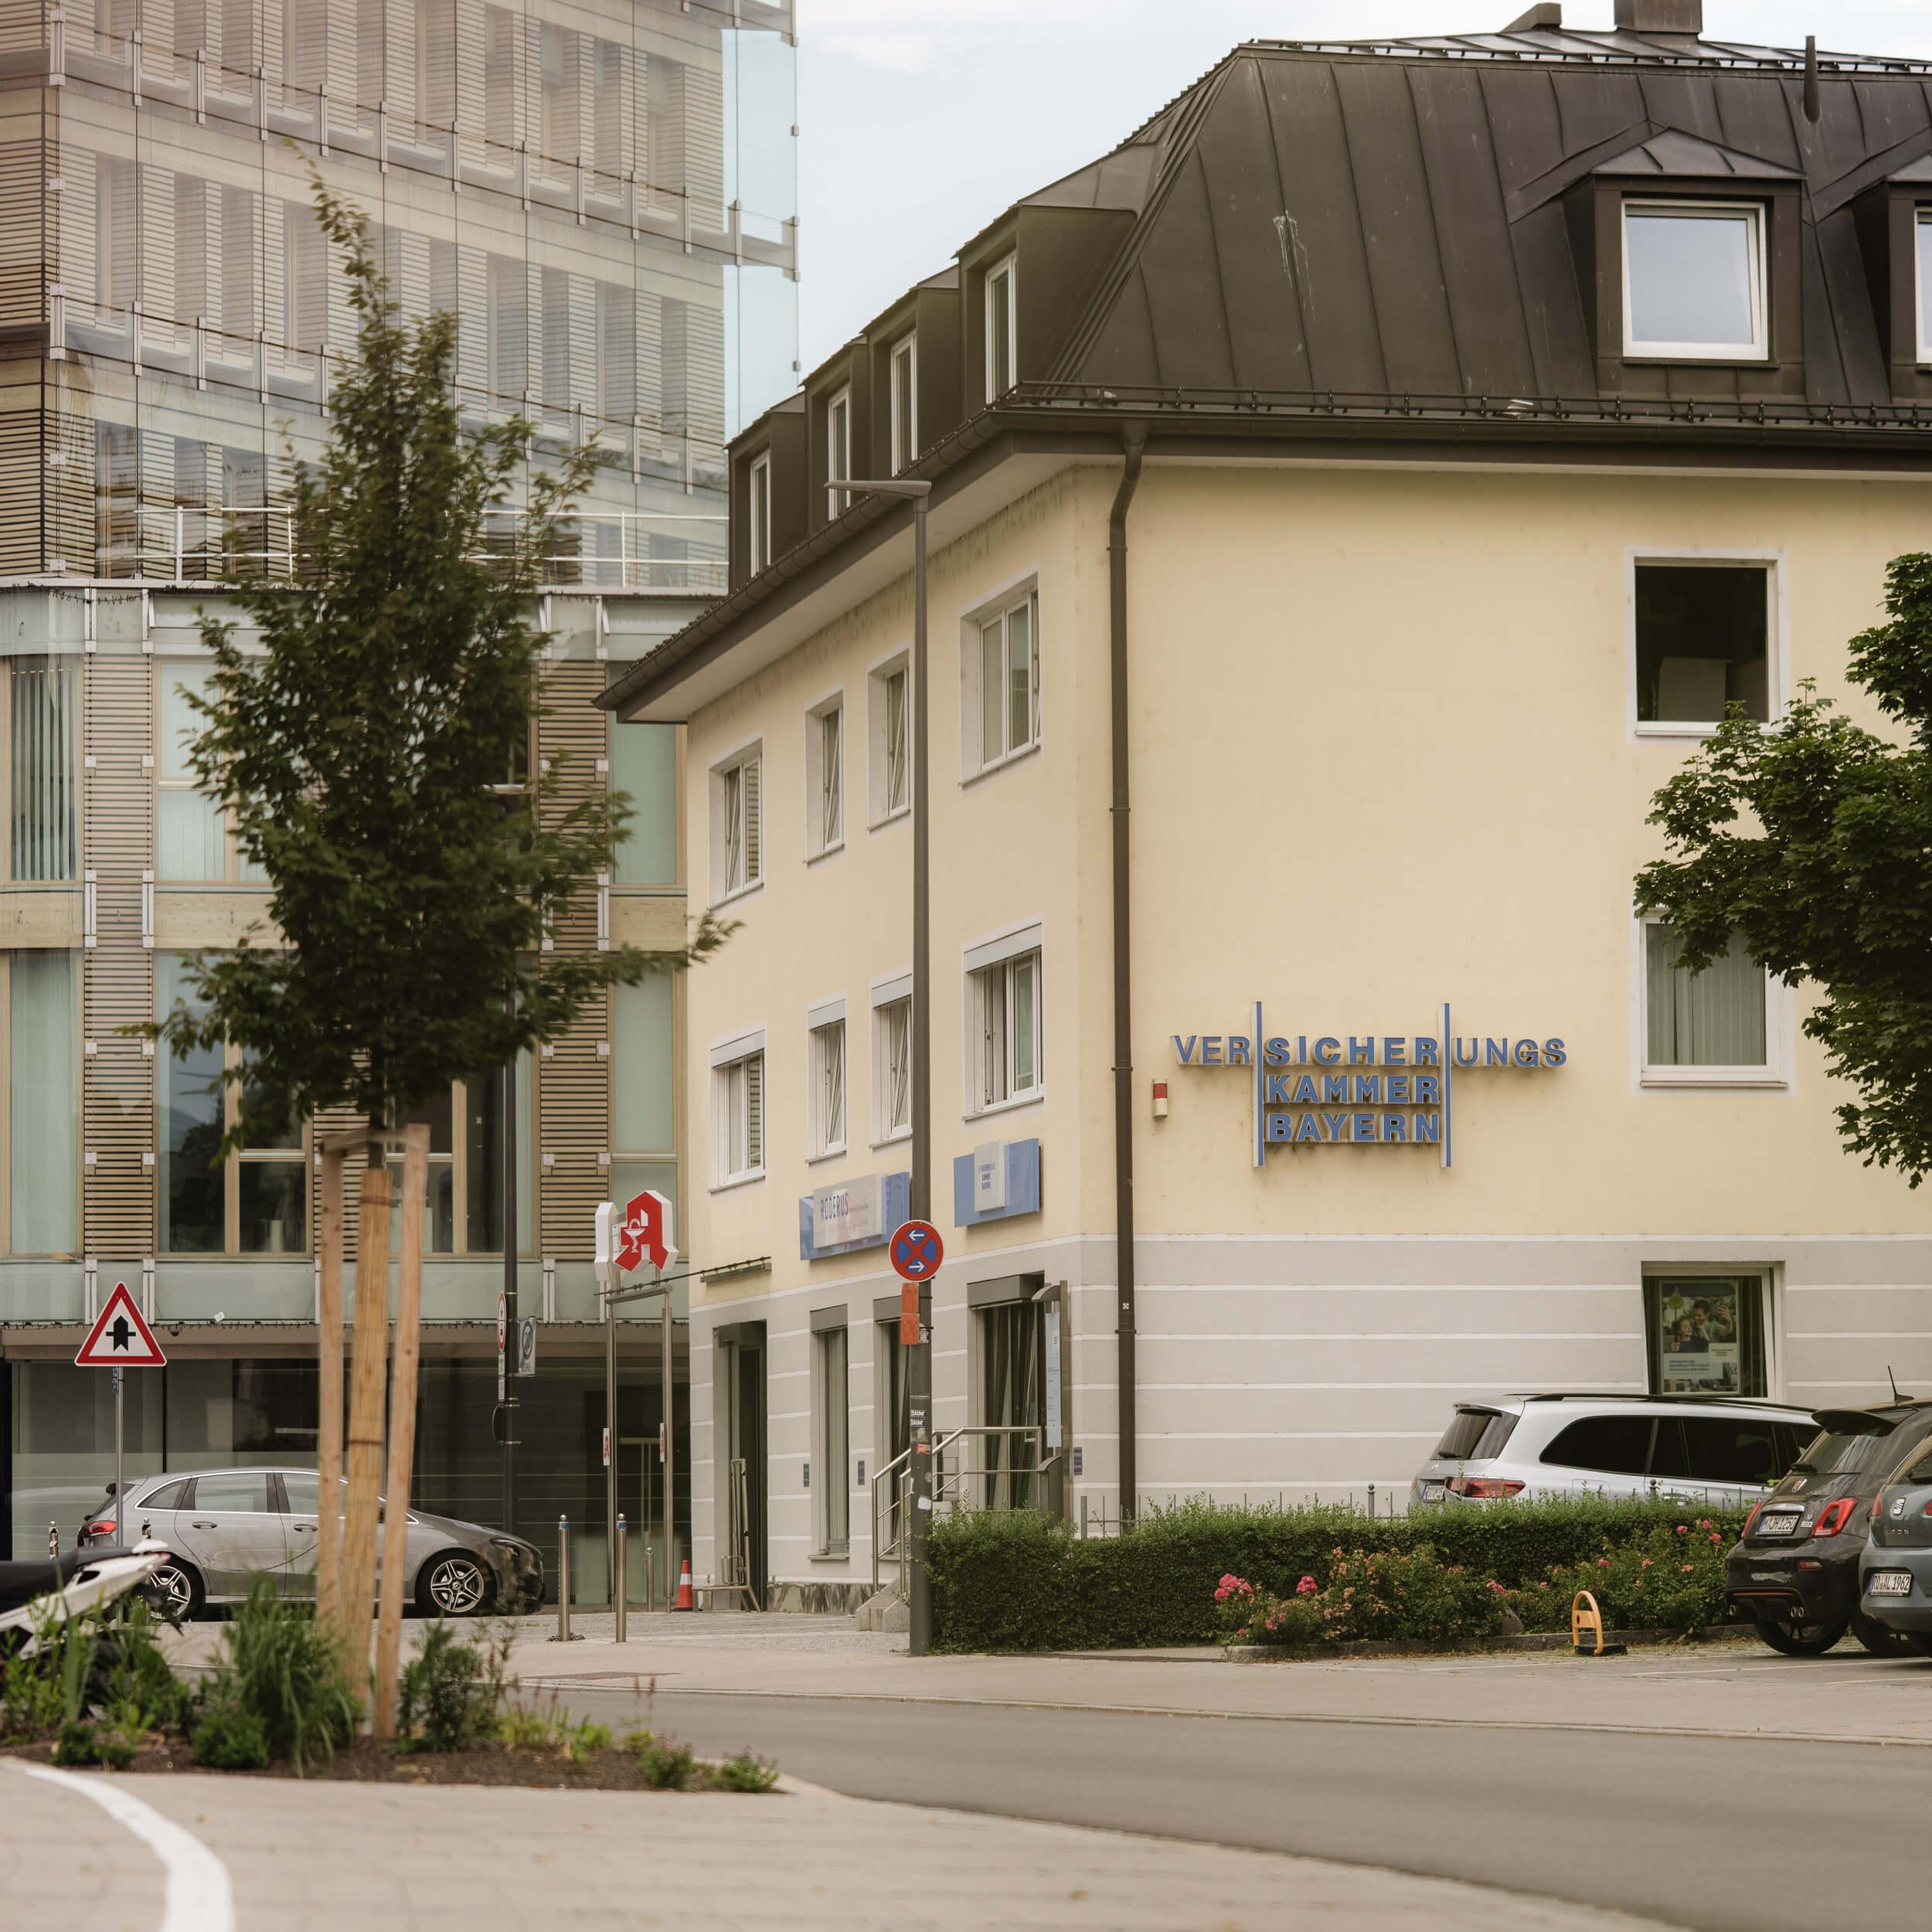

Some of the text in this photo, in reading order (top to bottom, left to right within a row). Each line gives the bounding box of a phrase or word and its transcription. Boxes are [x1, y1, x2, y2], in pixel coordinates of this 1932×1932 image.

[1265, 1075, 1439, 1104] KAMMER
[1265, 1113, 1439, 1142] BAYERN
[821, 1192, 849, 1221] RODERUS
